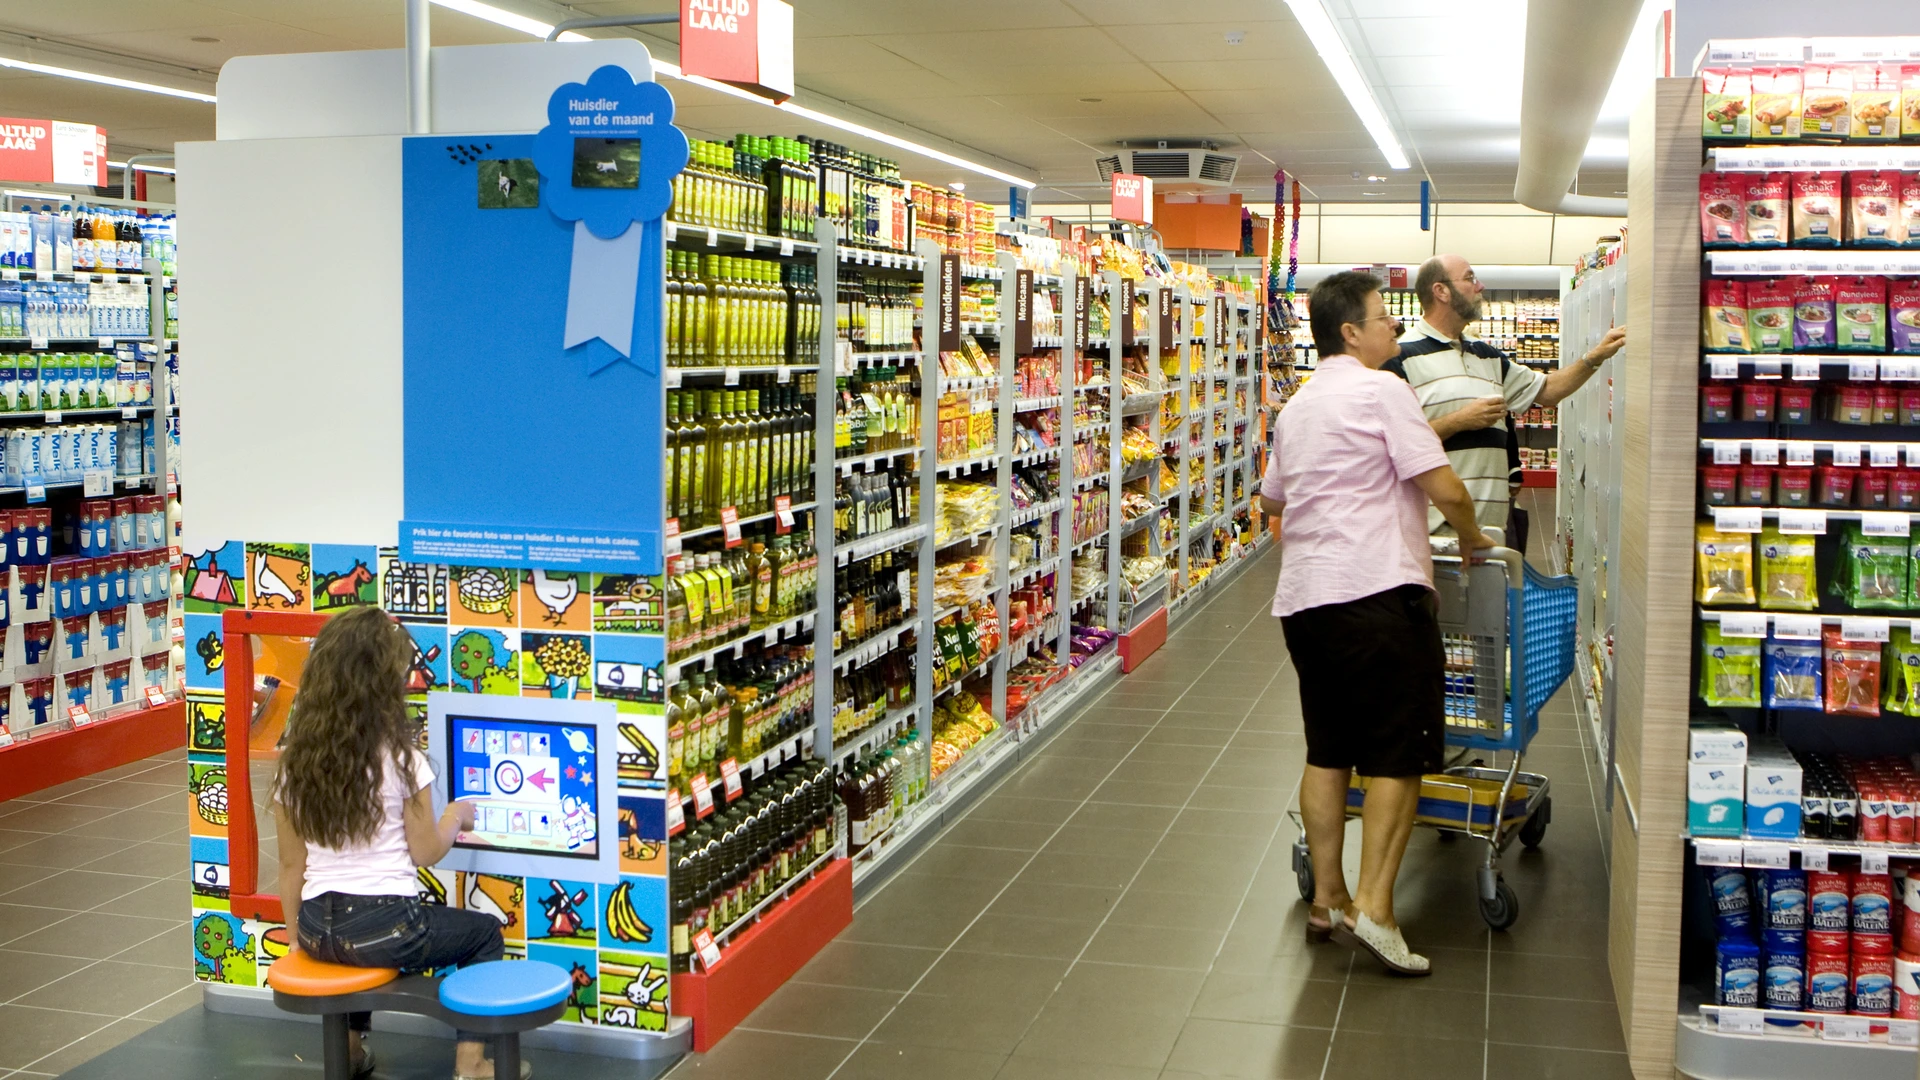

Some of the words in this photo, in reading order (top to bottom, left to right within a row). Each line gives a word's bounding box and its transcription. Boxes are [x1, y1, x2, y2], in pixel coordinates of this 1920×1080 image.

[689, 9, 738, 33] LAAG
[569, 98, 619, 111] Huisdier
[568, 116, 590, 126] van
[594, 113, 609, 126] de
[612, 112, 654, 125] maand
[1116, 178, 1141, 190] ALTIJD
[1750, 186, 1782, 195] Gehakt
[1800, 183, 1834, 192] Gehakt
[1116, 187, 1136, 198] LAAG
[942, 260, 953, 333] Wereldkeuken
[1018, 273, 1028, 321] Mexicaans
[1076, 280, 1085, 311] Chinees
[1122, 281, 1130, 315] Kroepoek
[1723, 294, 1736, 302] Kip
[1752, 295, 1790, 303] Lamsvlees
[1840, 291, 1878, 299] Rundvlees
[1076, 320, 1084, 348] Japans
[32, 436, 40, 473] Melk
[52, 435, 61, 471] Melk
[413, 528, 427, 536] Prik
[428, 529, 441, 537] hier
[453, 530, 483, 539] favoriete
[484, 531, 498, 540] foto
[525, 533, 554, 542] huisdier.
[556, 535, 565, 543] En
[566, 536, 580, 544] win
[595, 536, 611, 545] leuk
[612, 537, 641, 546] cadeau.
[1854, 918, 1889, 930] BALEINE
